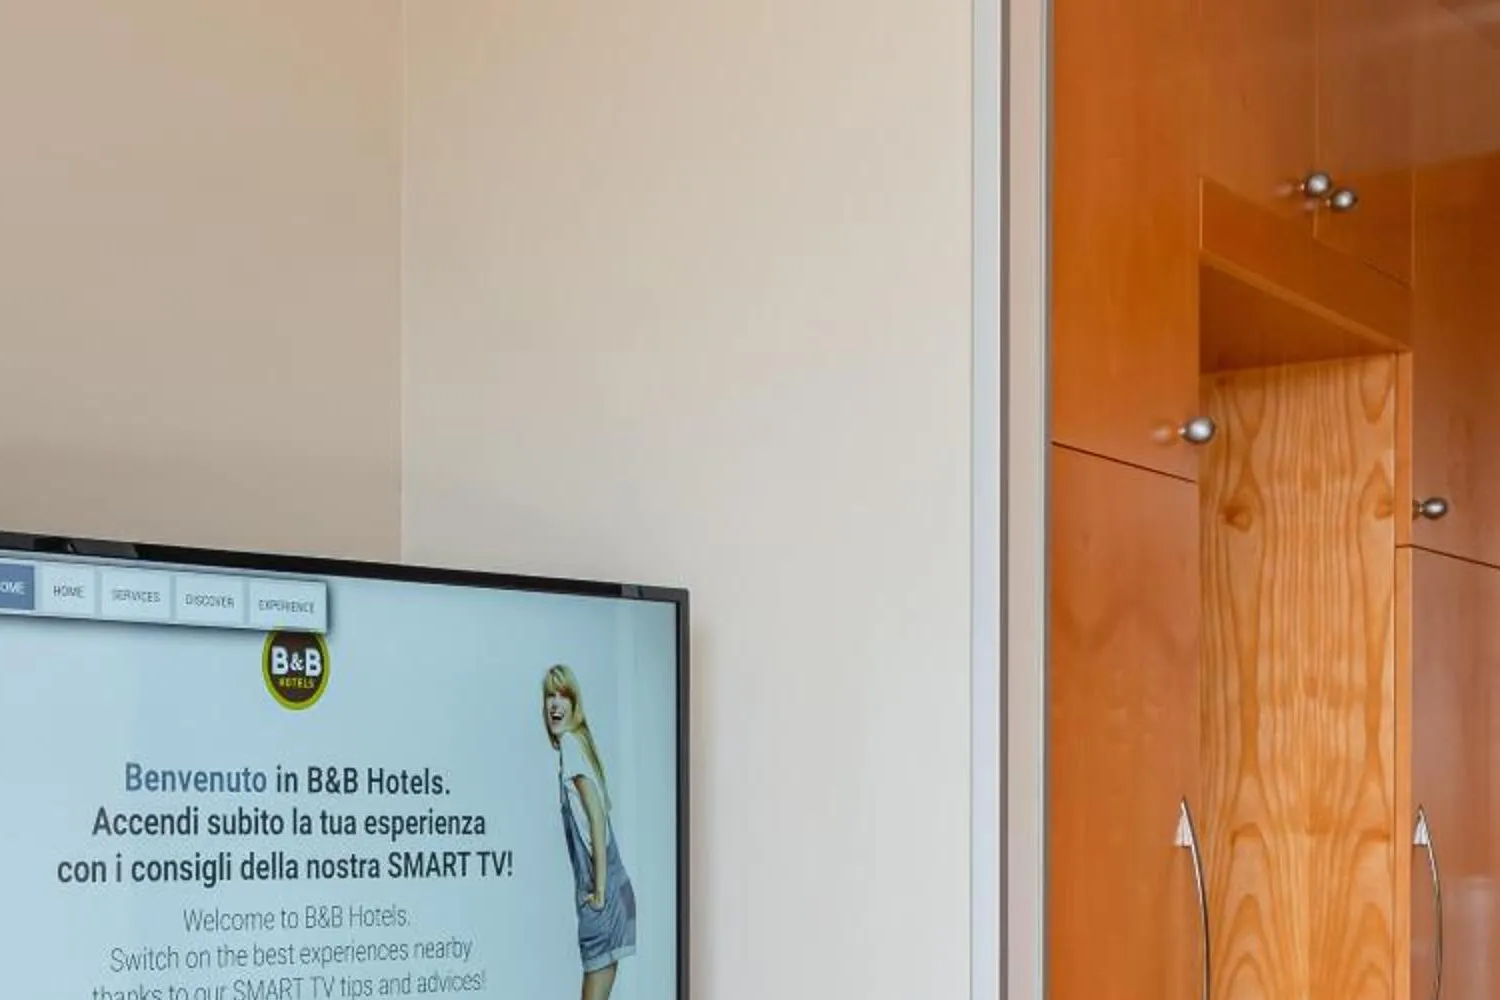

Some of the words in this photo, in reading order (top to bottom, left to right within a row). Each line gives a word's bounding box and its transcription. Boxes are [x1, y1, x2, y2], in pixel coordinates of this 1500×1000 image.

[53, 584, 85, 599] HOME
[111, 588, 161, 603] SERVICES
[185, 593, 235, 609] DISCOVER
[258, 598, 315, 614] EXPERIENCE
[271, 645, 322, 676] B&B
[125, 762, 267, 793] Benvenuto
[275, 764, 298, 793] in
[307, 766, 358, 794] B&B
[367, 767, 451, 795] Hotels.
[91, 805, 199, 836] Accendi
[207, 806, 284, 835] subito
[292, 805, 313, 835] la
[320, 809, 357, 835] tua
[364, 807, 486, 842] esperienza
[57, 860, 107, 883] con
[115, 852, 123, 882] i
[131, 852, 232, 889] consigli
[240, 851, 299, 881] della
[306, 853, 380, 880] nostra
[388, 851, 470, 879] SMART
[476, 850, 514, 877] TV!
[183, 908, 275, 932] Welcome
[281, 908, 299, 930] to
[305, 905, 343, 929] B&B
[350, 903, 411, 928] Hotels.
[110, 946, 179, 973] Switch
[185, 950, 211, 969] on
[217, 944, 248, 968] the
[253, 944, 295, 967] best
[300, 940, 409, 969] experiences
[414, 936, 473, 962] nearby
[310, 975, 335, 1000] TV
[341, 976, 373, 1000] tips
[379, 971, 411, 996] and
[417, 969, 486, 994] advices!
